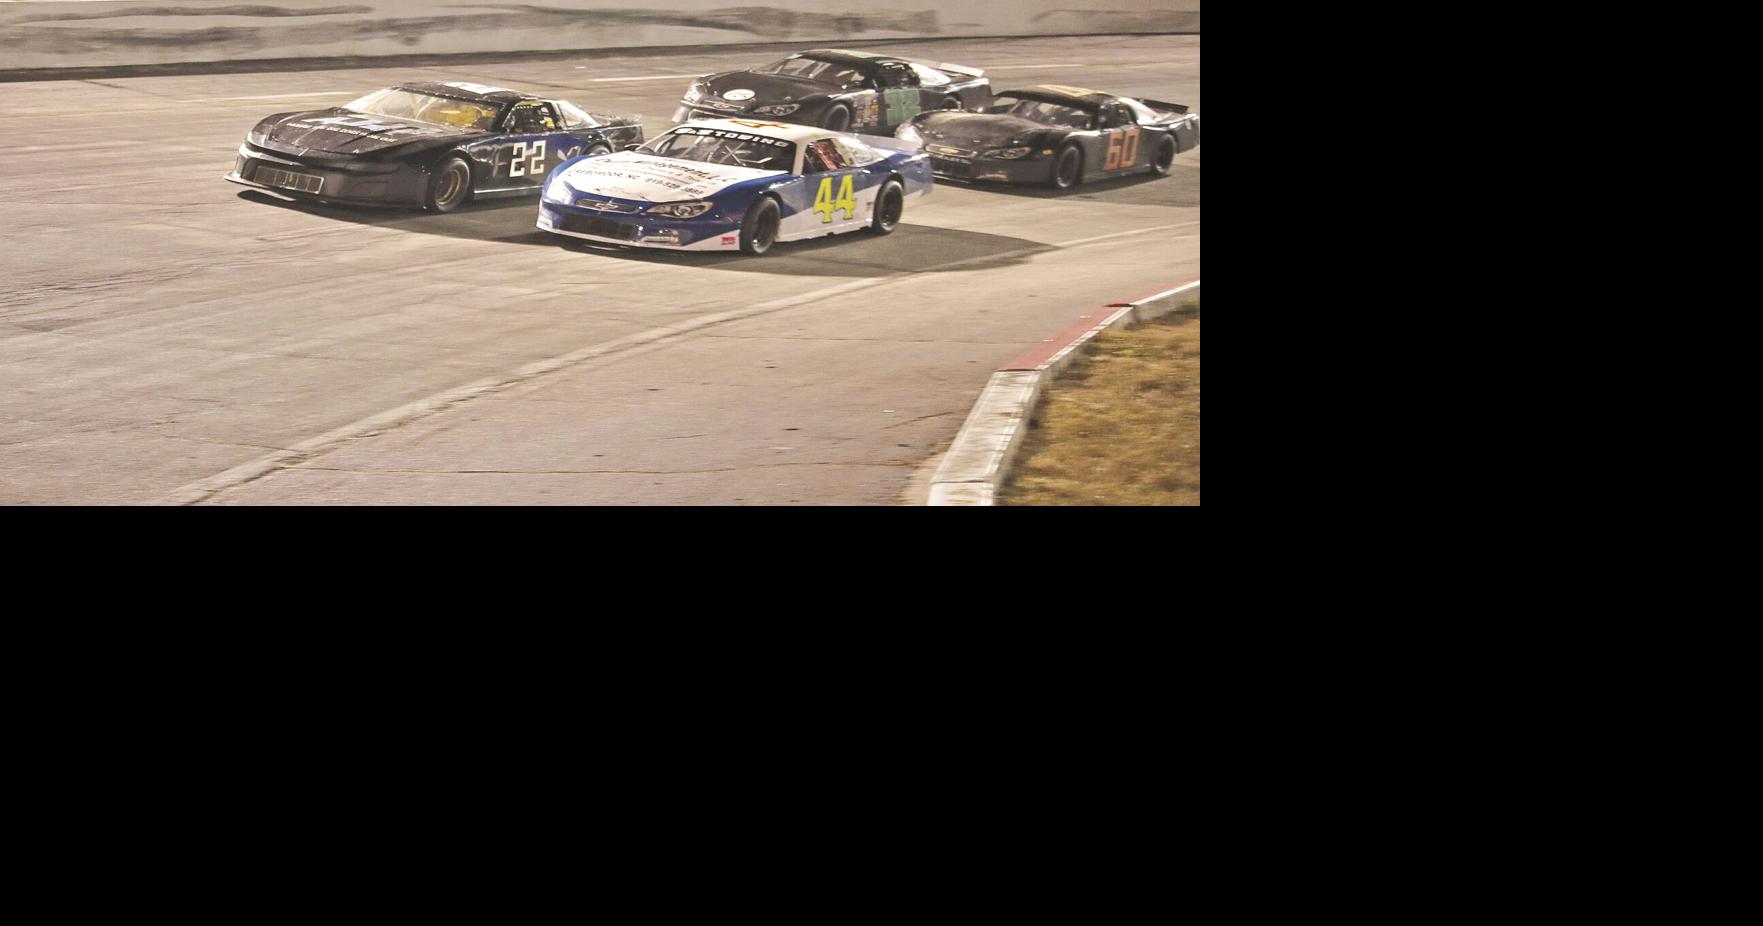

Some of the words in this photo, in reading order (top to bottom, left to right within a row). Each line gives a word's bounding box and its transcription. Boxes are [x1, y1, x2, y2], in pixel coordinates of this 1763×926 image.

[509, 140, 546, 178] 22
[714, 131, 790, 148] TOWING
[1103, 127, 1140, 170] 60
[813, 174, 857, 224] 44
